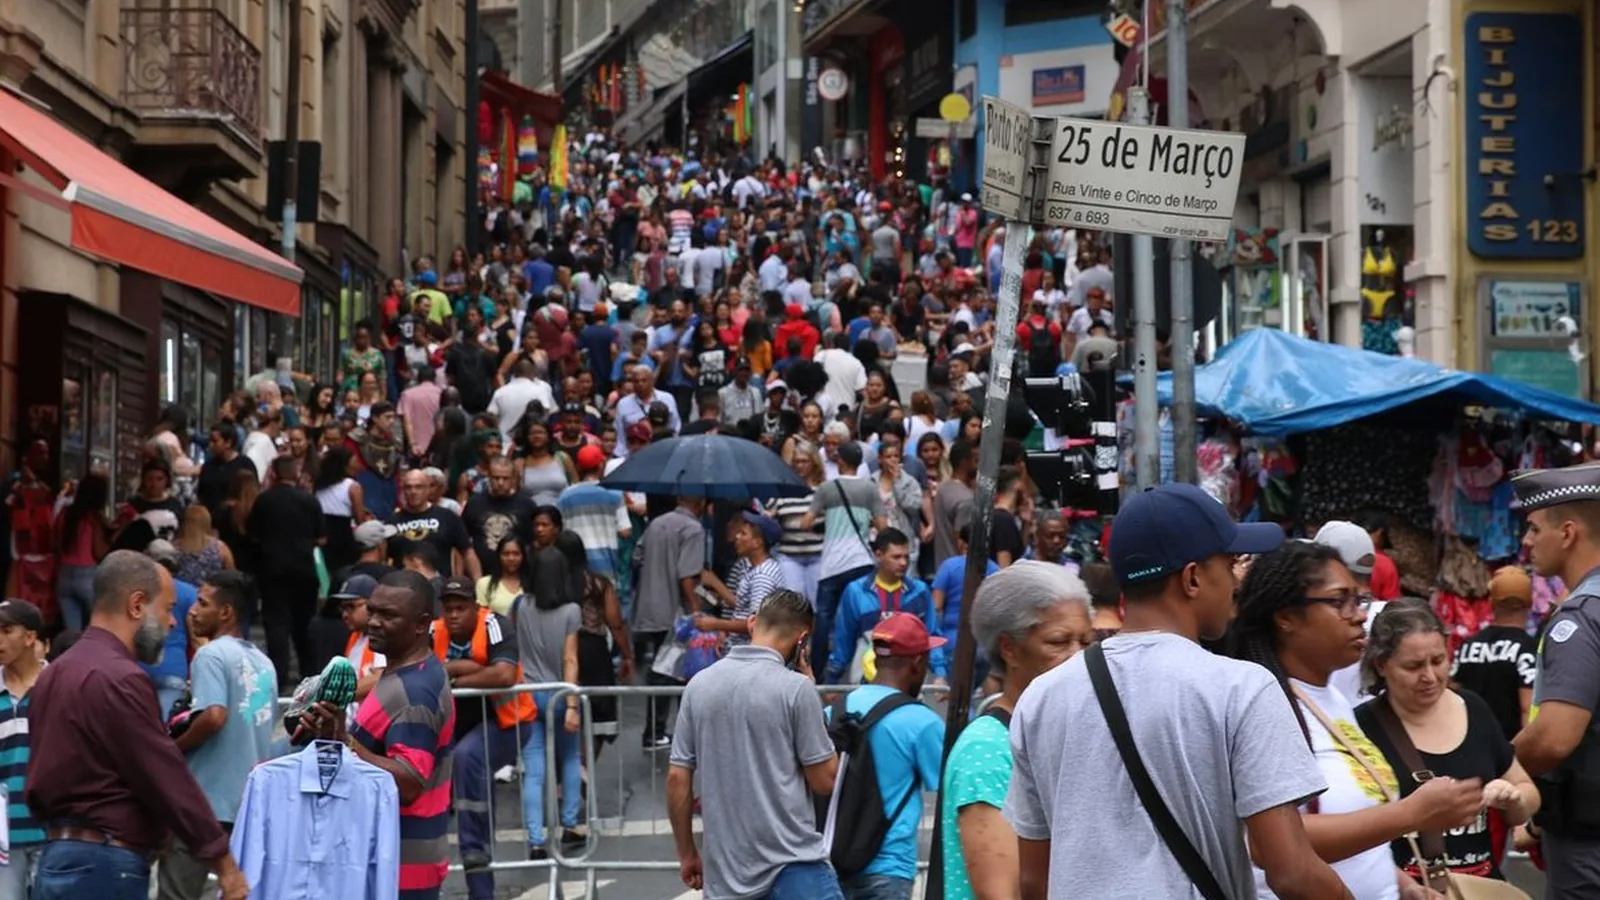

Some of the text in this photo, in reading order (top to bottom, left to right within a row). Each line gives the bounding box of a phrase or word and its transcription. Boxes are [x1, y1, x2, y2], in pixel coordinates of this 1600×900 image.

[986, 103, 1011, 151] Porto
[1478, 26, 1519, 241] BIJUTERIAS
[1057, 125, 1234, 188] 25 de Março
[1051, 181, 1218, 214] Rua Vinte e Cinco de Março
[1048, 206, 1110, 225] 637 a 693
[1526, 219, 1578, 242] 123
[396, 518, 440, 532] WORLD
[1128, 566, 1162, 579] OAKLEY
